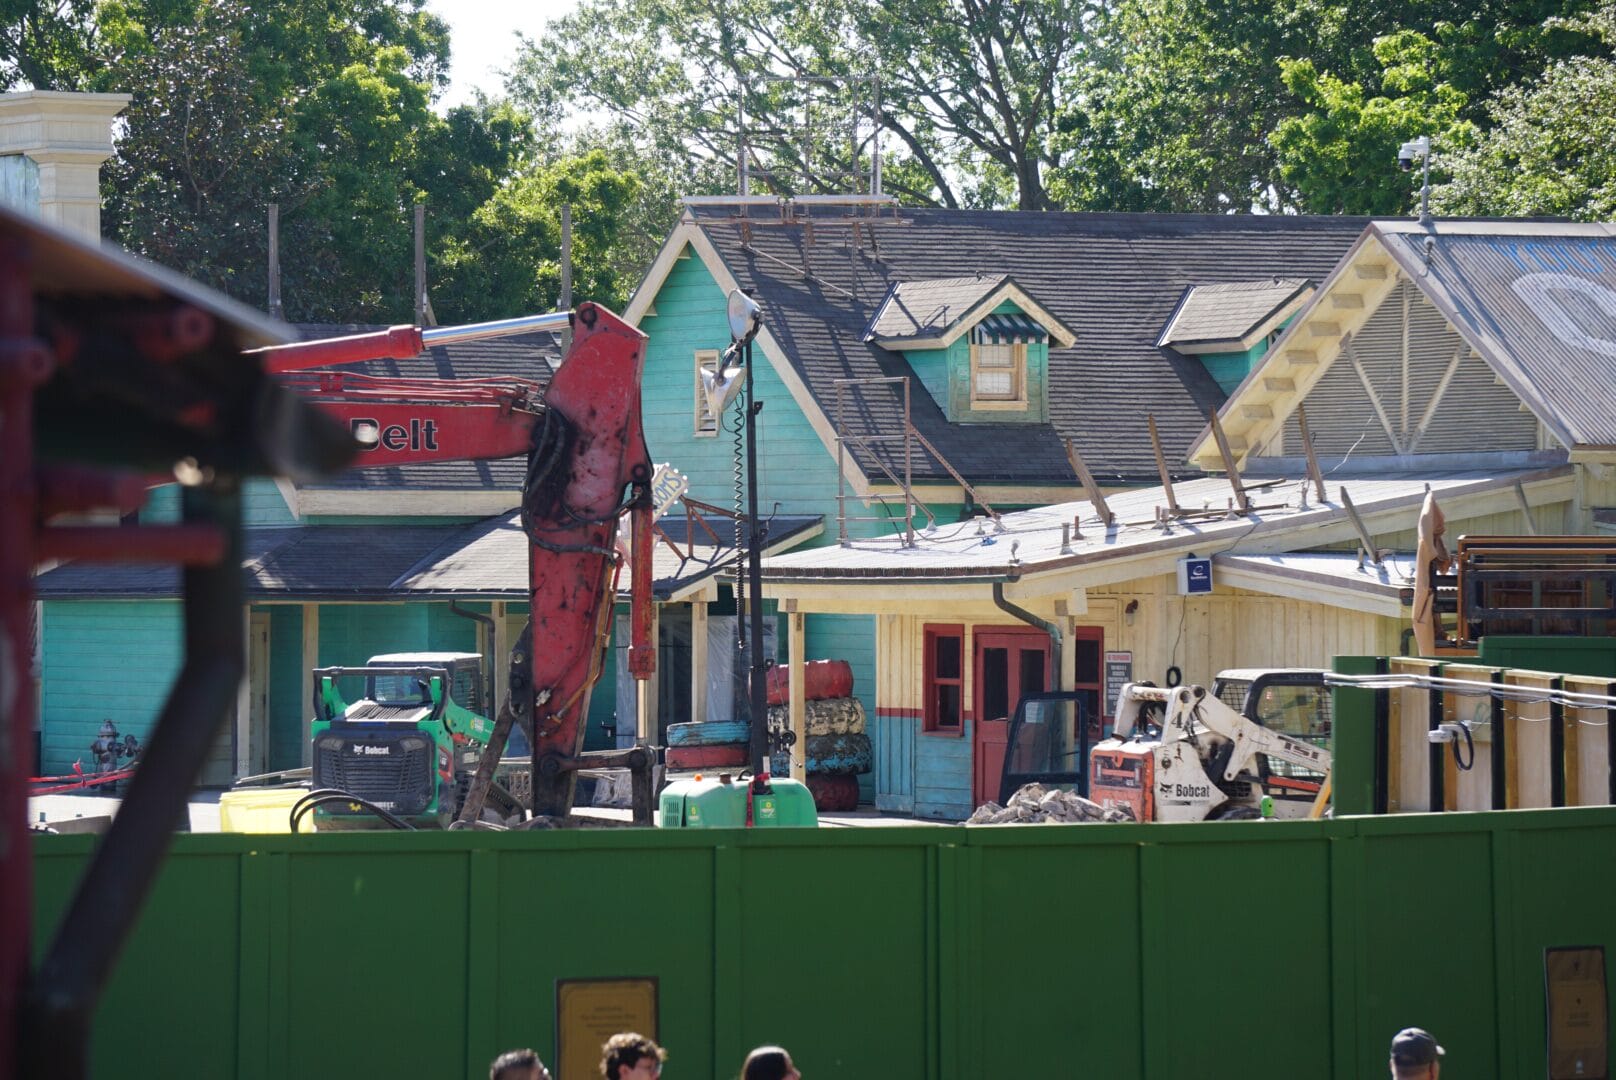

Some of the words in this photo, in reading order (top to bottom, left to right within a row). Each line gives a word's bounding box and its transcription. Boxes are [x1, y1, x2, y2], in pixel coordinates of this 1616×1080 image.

[350, 417, 438, 451] Belt
[364, 746, 389, 755] Bobcat
[1176, 784, 1210, 798] Bobcat
